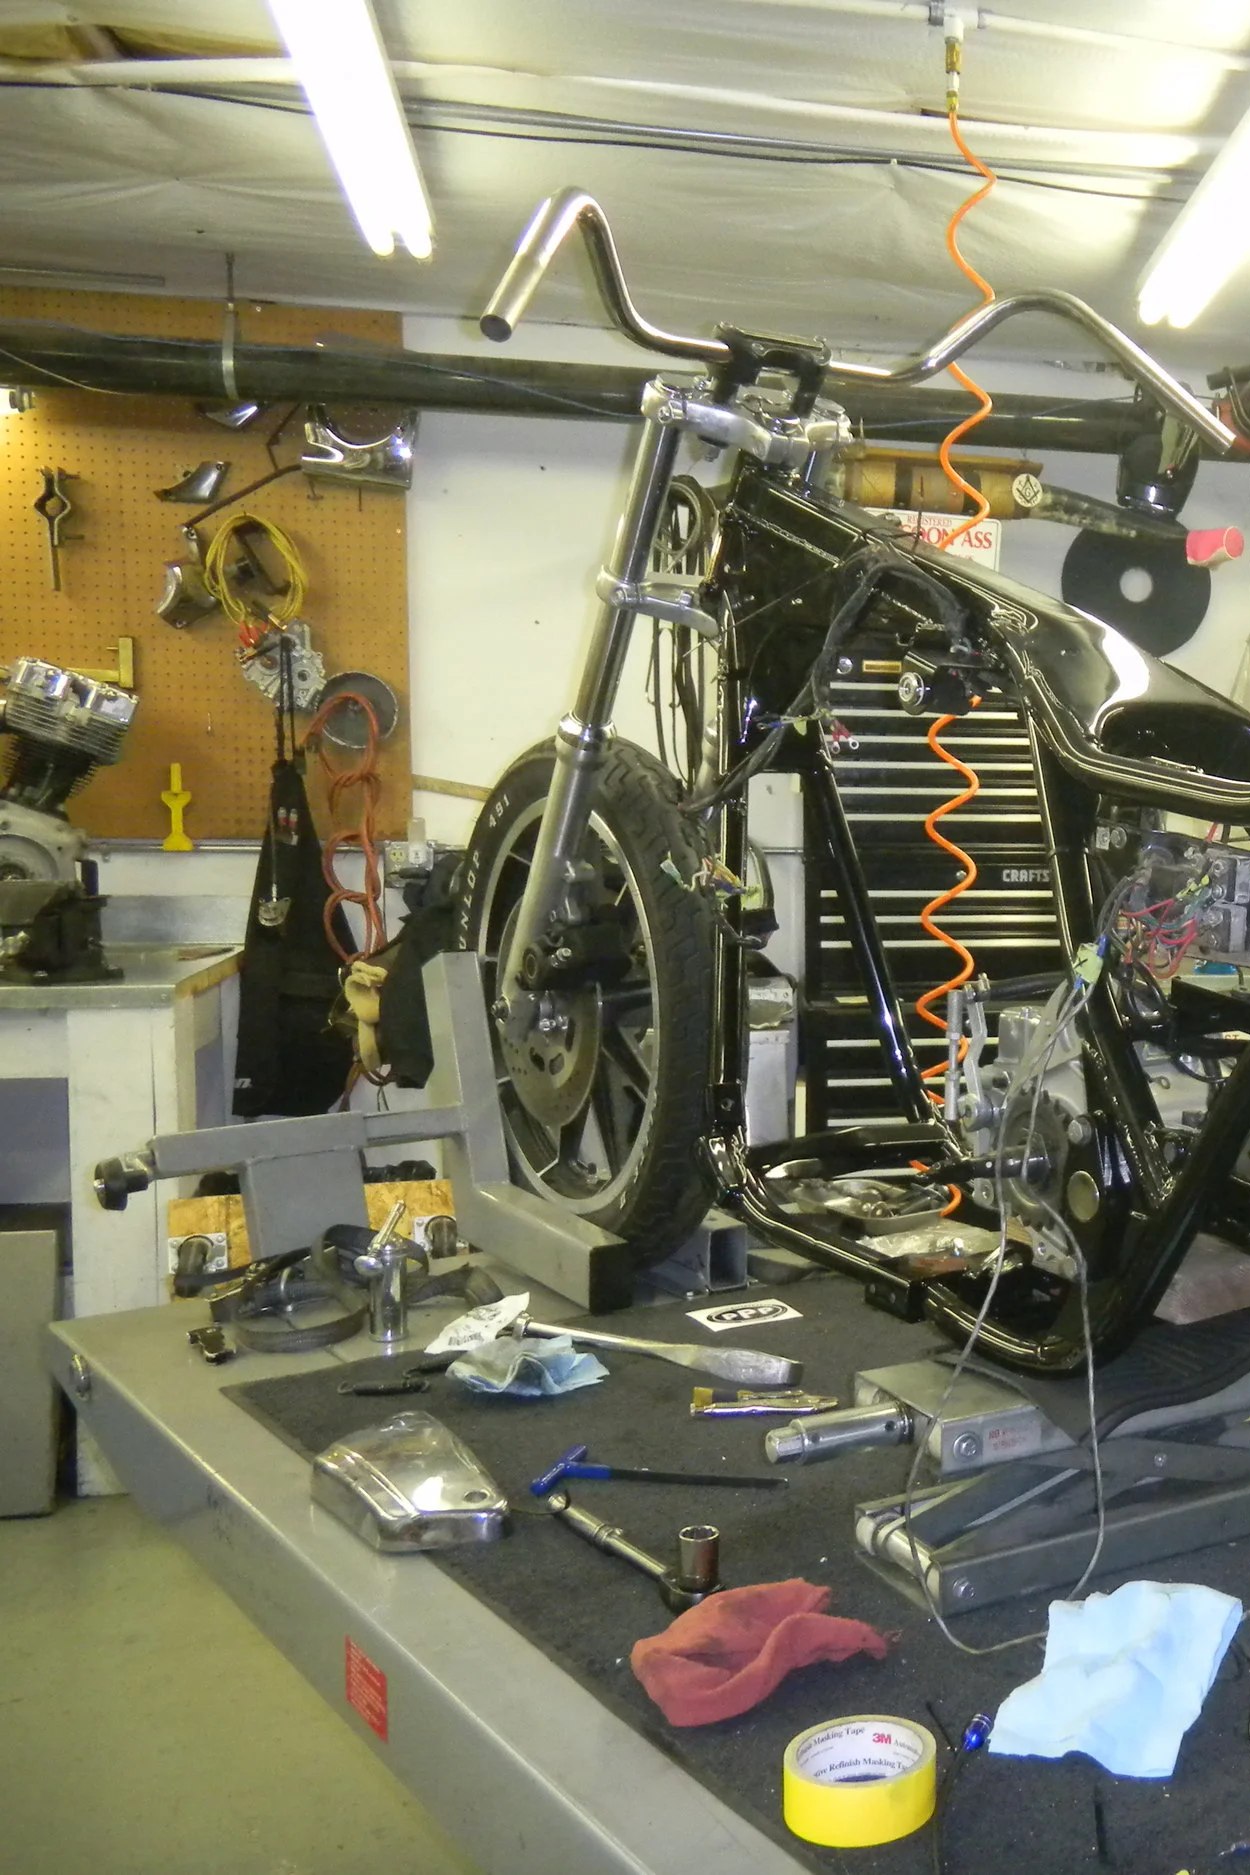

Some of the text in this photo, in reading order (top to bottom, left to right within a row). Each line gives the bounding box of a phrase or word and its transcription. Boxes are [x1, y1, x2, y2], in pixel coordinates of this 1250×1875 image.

[907, 515, 952, 527] REISTERED
[961, 530, 992, 549] ASS
[489, 793, 510, 828] 491
[1002, 869, 1050, 882] CRAFTS
[459, 850, 480, 950] UNLOP
[813, 1730, 844, 1746] Masking
[845, 1726, 865, 1736] Tape
[872, 1733, 892, 1745] 3M
[829, 1757, 861, 1772] Refinish
[863, 1757, 896, 1769] Masking
